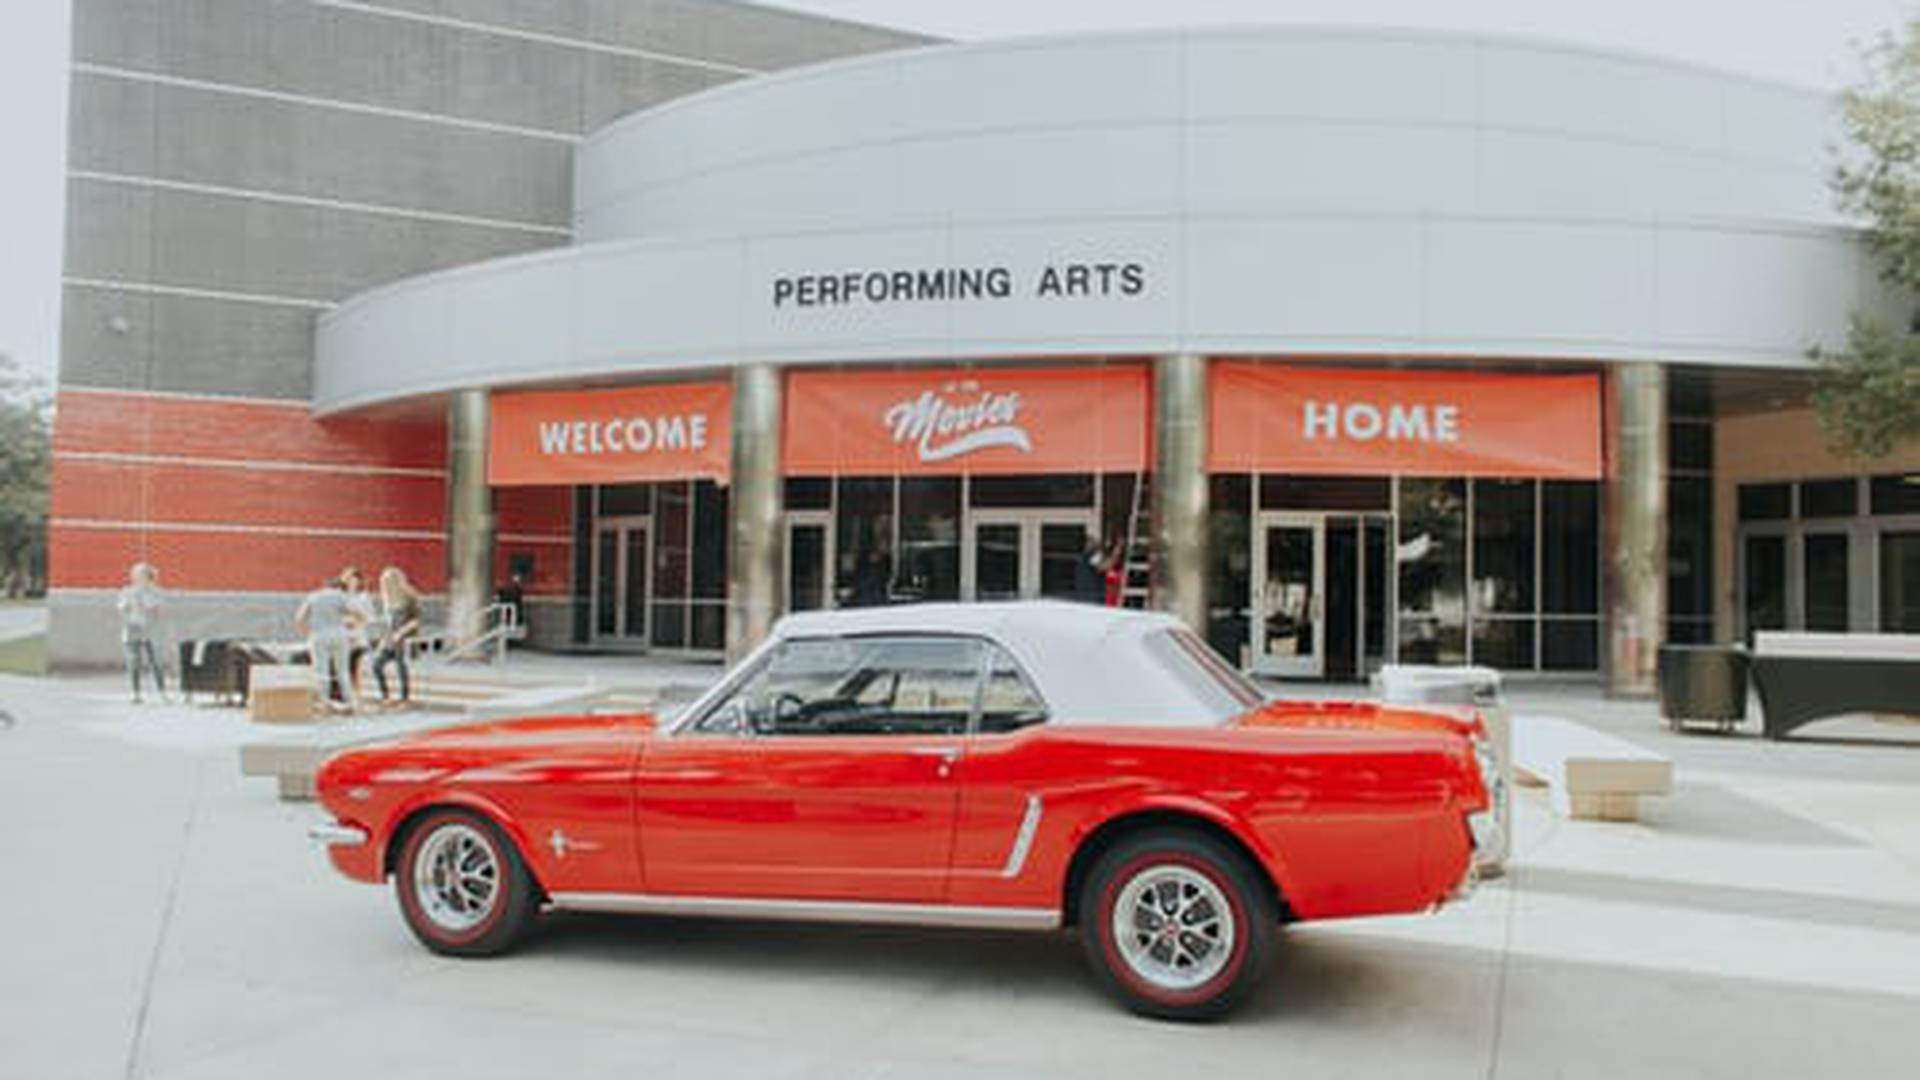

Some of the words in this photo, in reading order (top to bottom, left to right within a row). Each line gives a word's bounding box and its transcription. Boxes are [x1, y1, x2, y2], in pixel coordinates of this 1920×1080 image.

[774, 268, 1011, 307] PERFORMING
[1037, 263, 1145, 297] ARTS
[539, 413, 707, 454] WELCOME
[884, 391, 1032, 462] Movies
[1304, 400, 1458, 440] HOME
